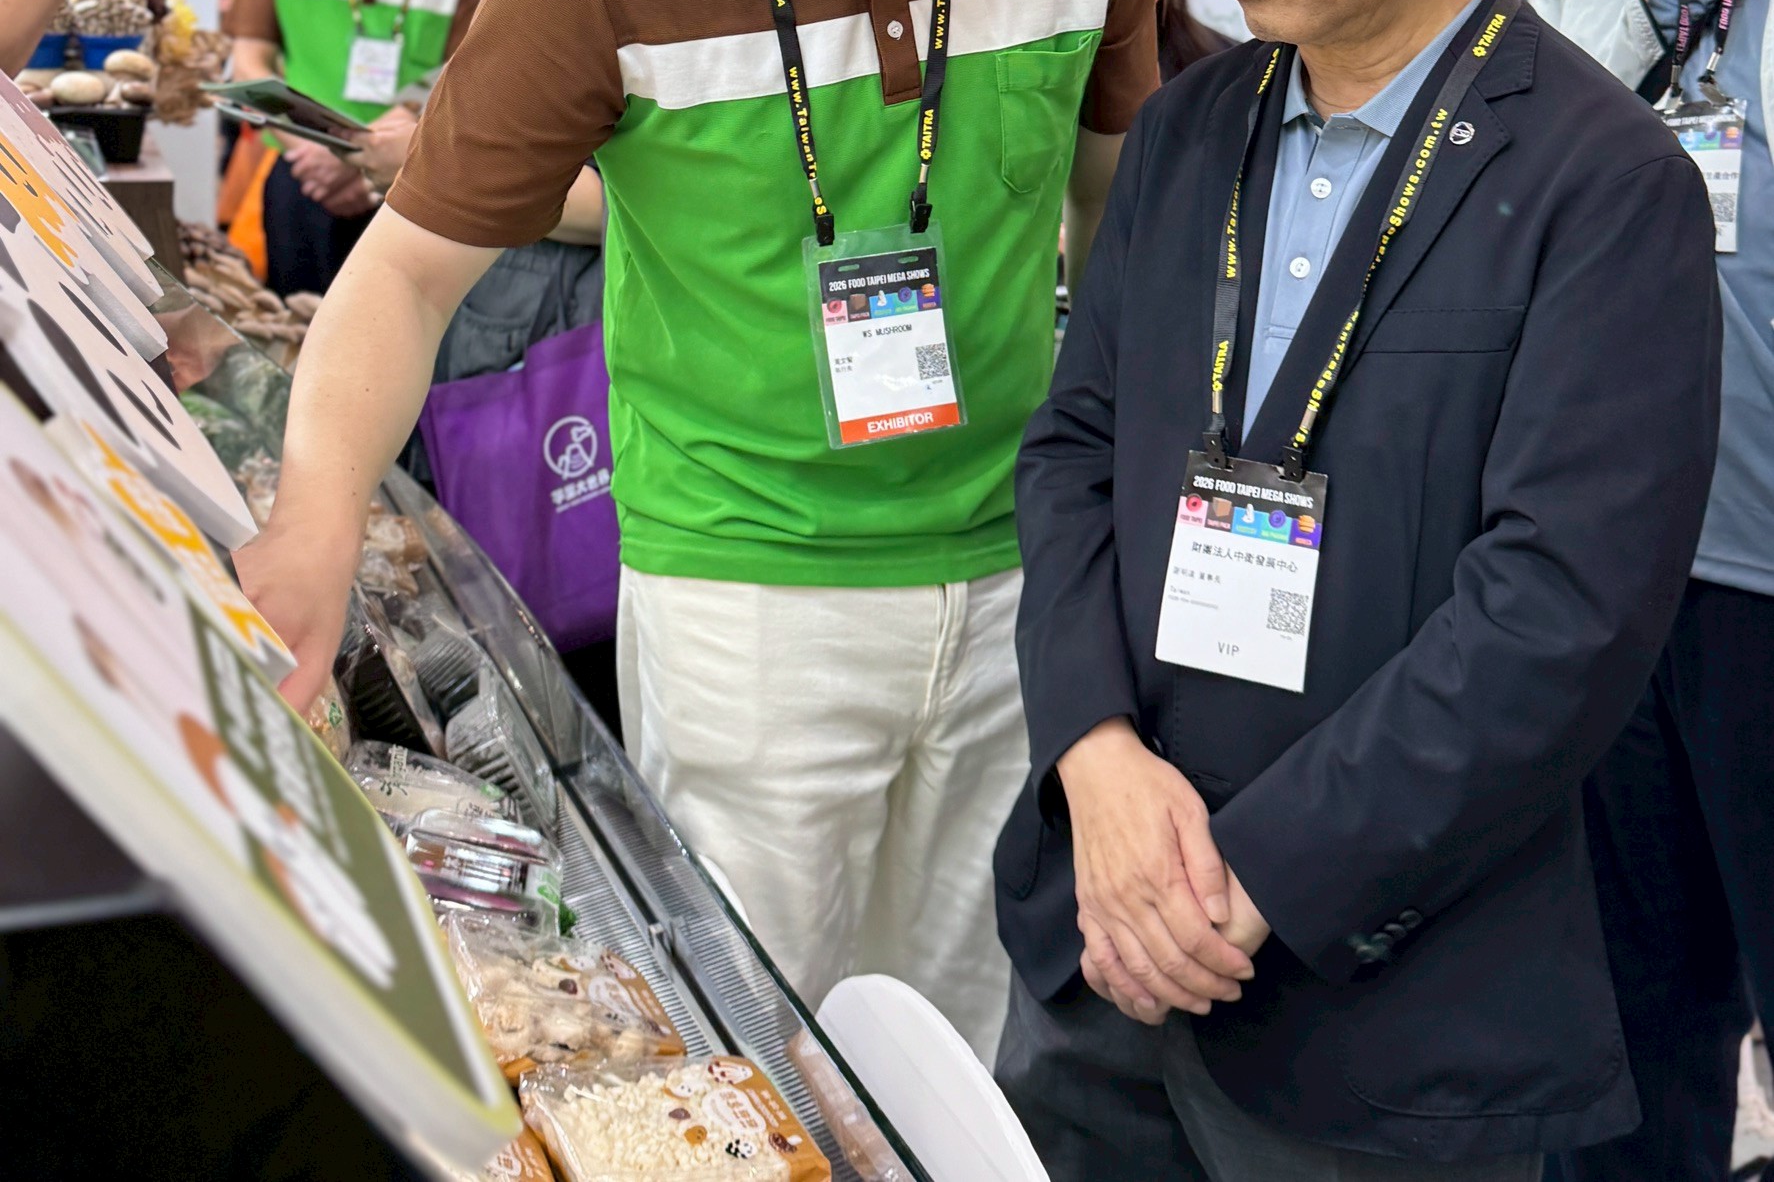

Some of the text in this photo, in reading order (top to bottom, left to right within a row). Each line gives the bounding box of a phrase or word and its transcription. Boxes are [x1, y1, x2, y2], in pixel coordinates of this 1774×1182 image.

[1479, 13, 1506, 48] TAITRA
[921, 108, 935, 149] TAITRA
[828, 268, 930, 292] 2026 FOOD TAIPEI MEGA SHOWS
[862, 324, 913, 338] WS MUSHROOM
[1212, 339, 1230, 381] TAITRA
[866, 411, 934, 433] EXHIBITOR
[1193, 475, 1314, 509] 2026 FOOD TAIPEI MEGA SHOWS
[1217, 641, 1240, 657] VIP
